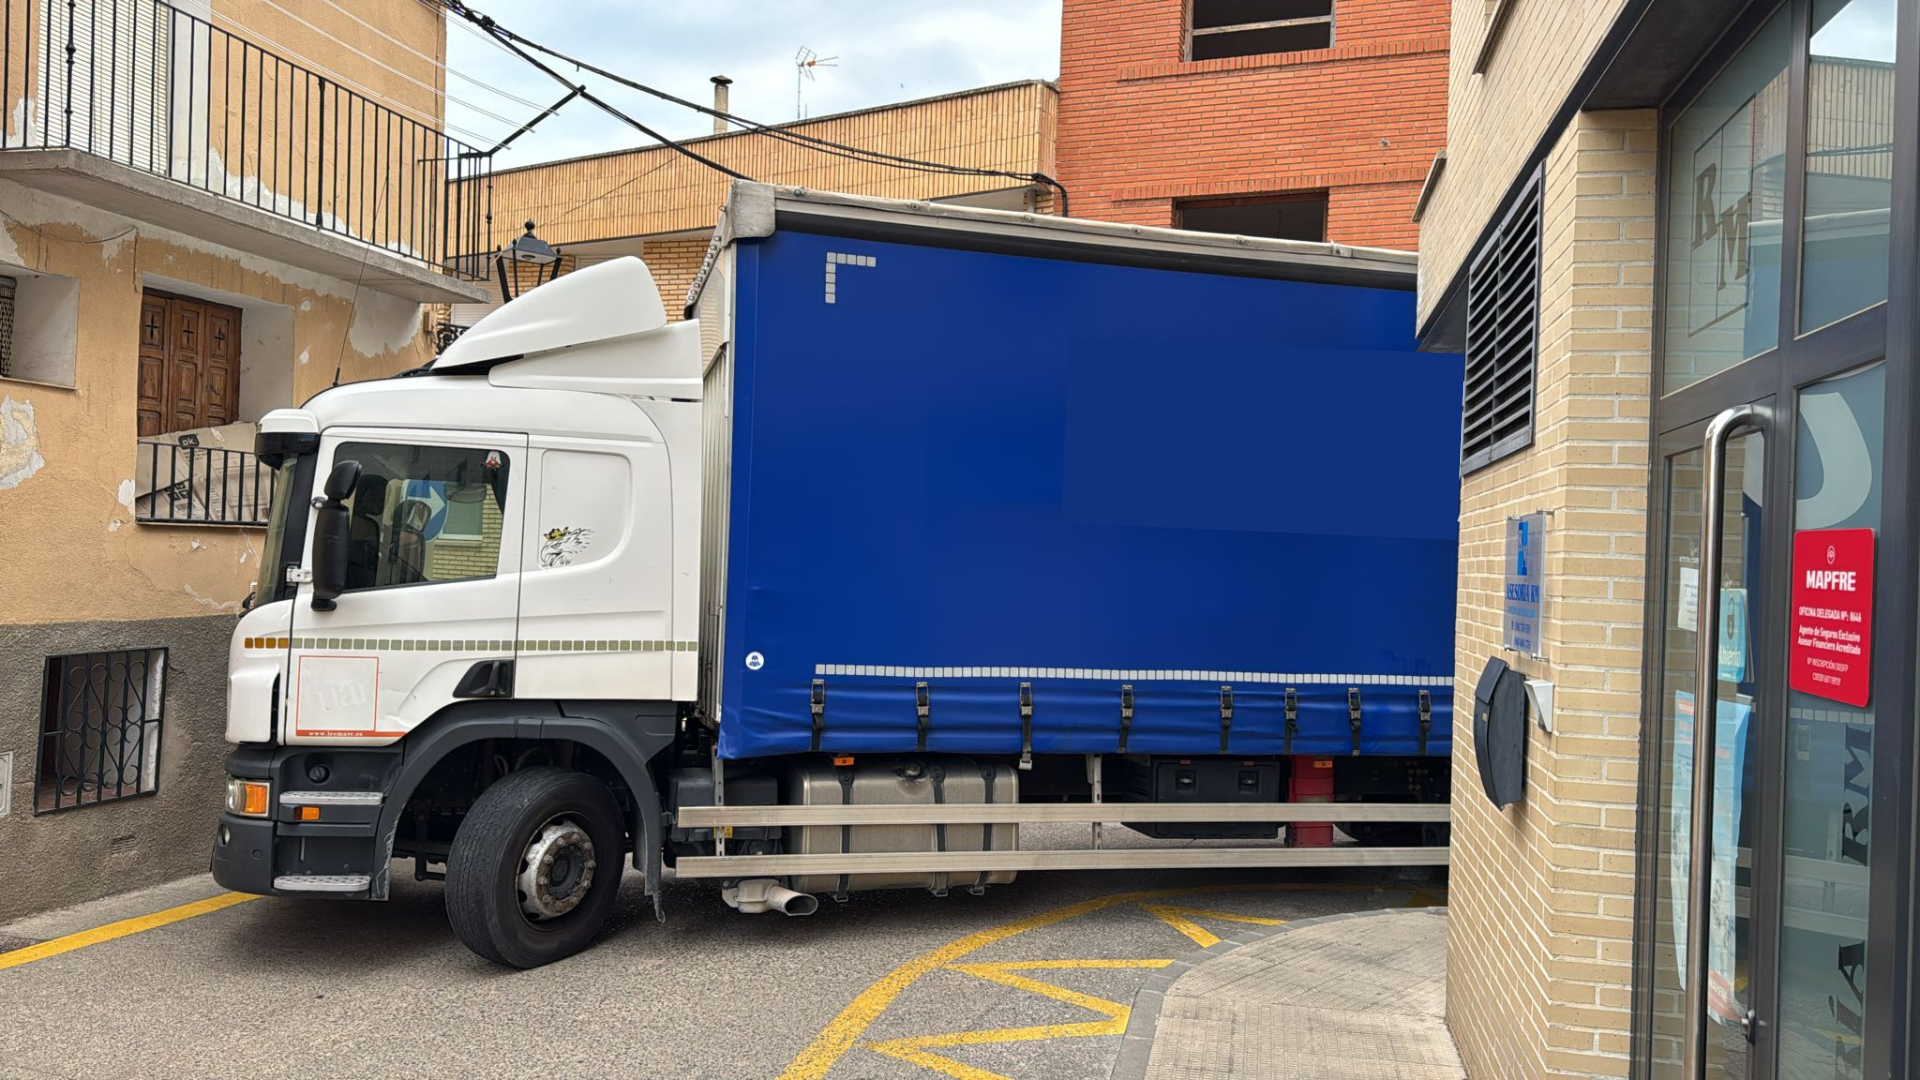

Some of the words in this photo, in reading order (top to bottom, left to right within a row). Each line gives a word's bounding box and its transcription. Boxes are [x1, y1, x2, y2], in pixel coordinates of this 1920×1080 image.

[1806, 570, 1856, 591] MAPFRE
[1798, 606, 1816, 617] OFICINA
[1816, 607, 1840, 620] DELEGADA
[1799, 624, 1814, 636] Agente
[1814, 626, 1820, 636] de
[1820, 627, 1838, 640] Seguros
[1838, 629, 1861, 643] Exclusivo
[1797, 635, 1812, 646] Asesor
[1813, 638, 1836, 651] Financiero
[1836, 642, 1861, 655] Acreditado
[1841, 723, 1873, 867] RM
